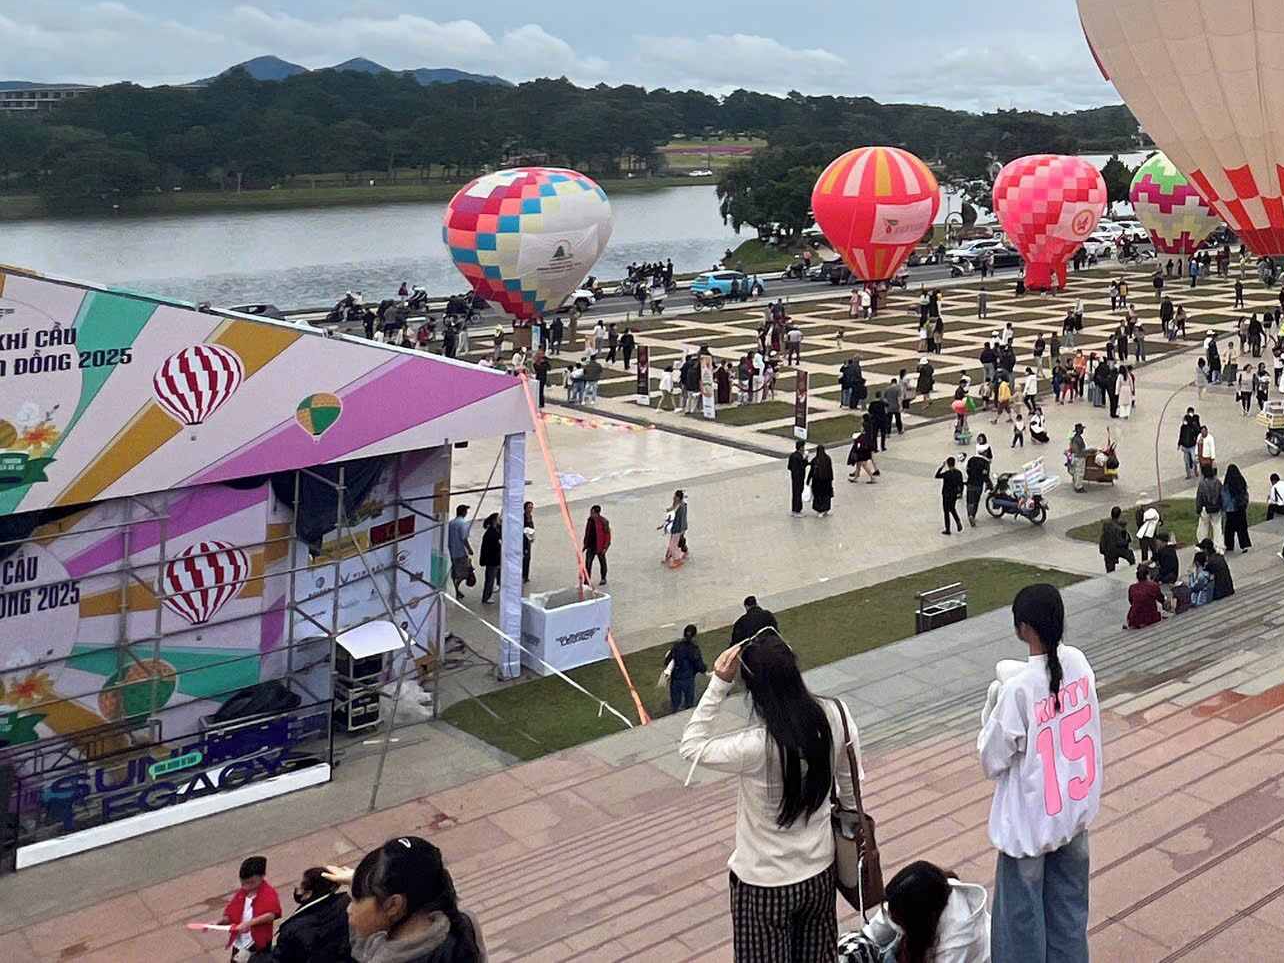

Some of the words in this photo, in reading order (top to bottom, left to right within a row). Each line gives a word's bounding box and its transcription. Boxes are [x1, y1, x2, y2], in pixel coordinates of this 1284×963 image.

[35, 321, 77, 348] CẦU
[78, 347, 133, 369] 2025
[37, 581, 80, 611] 2025
[1034, 676, 1090, 727] KITTY
[1036, 703, 1097, 817] 15
